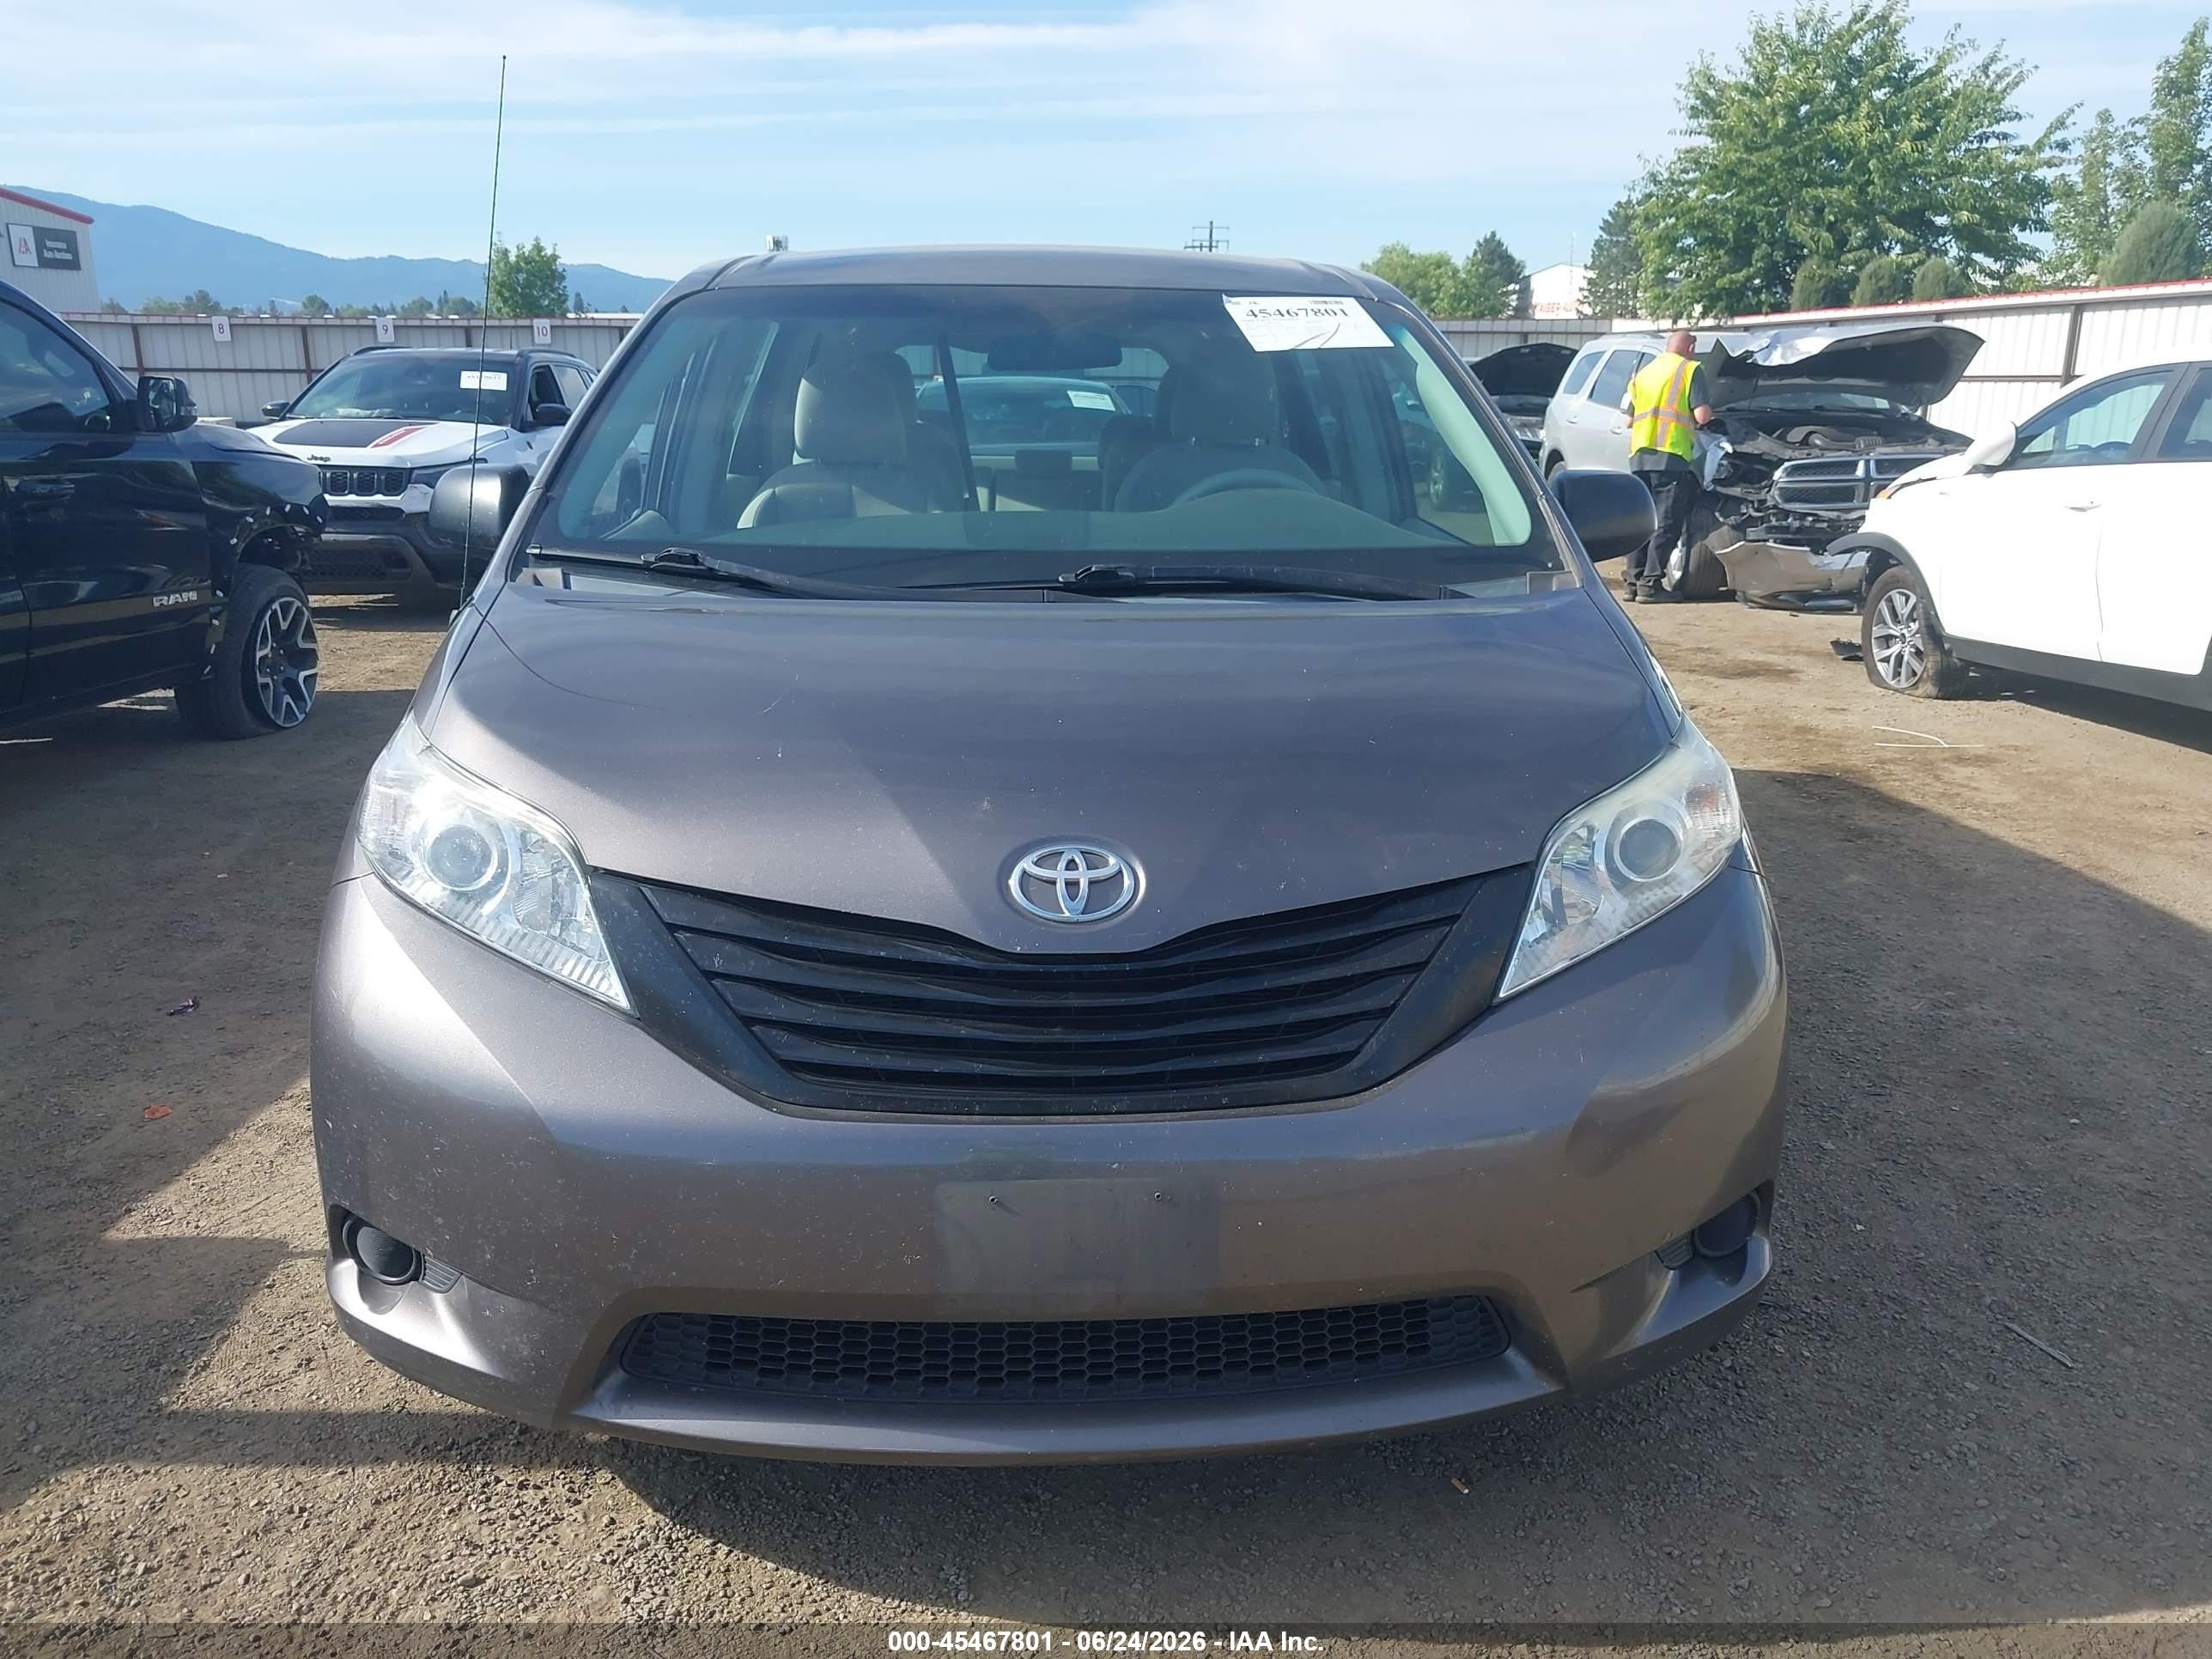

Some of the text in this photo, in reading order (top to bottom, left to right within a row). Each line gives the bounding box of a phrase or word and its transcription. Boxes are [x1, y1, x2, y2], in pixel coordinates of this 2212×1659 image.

[1245, 307, 1350, 319] 45467801
[217, 323, 225, 334] 8
[381, 324, 389, 335] 9
[536, 325, 549, 337] 10
[307, 454, 331, 463] Jeep
[153, 591, 198, 607] RAM
